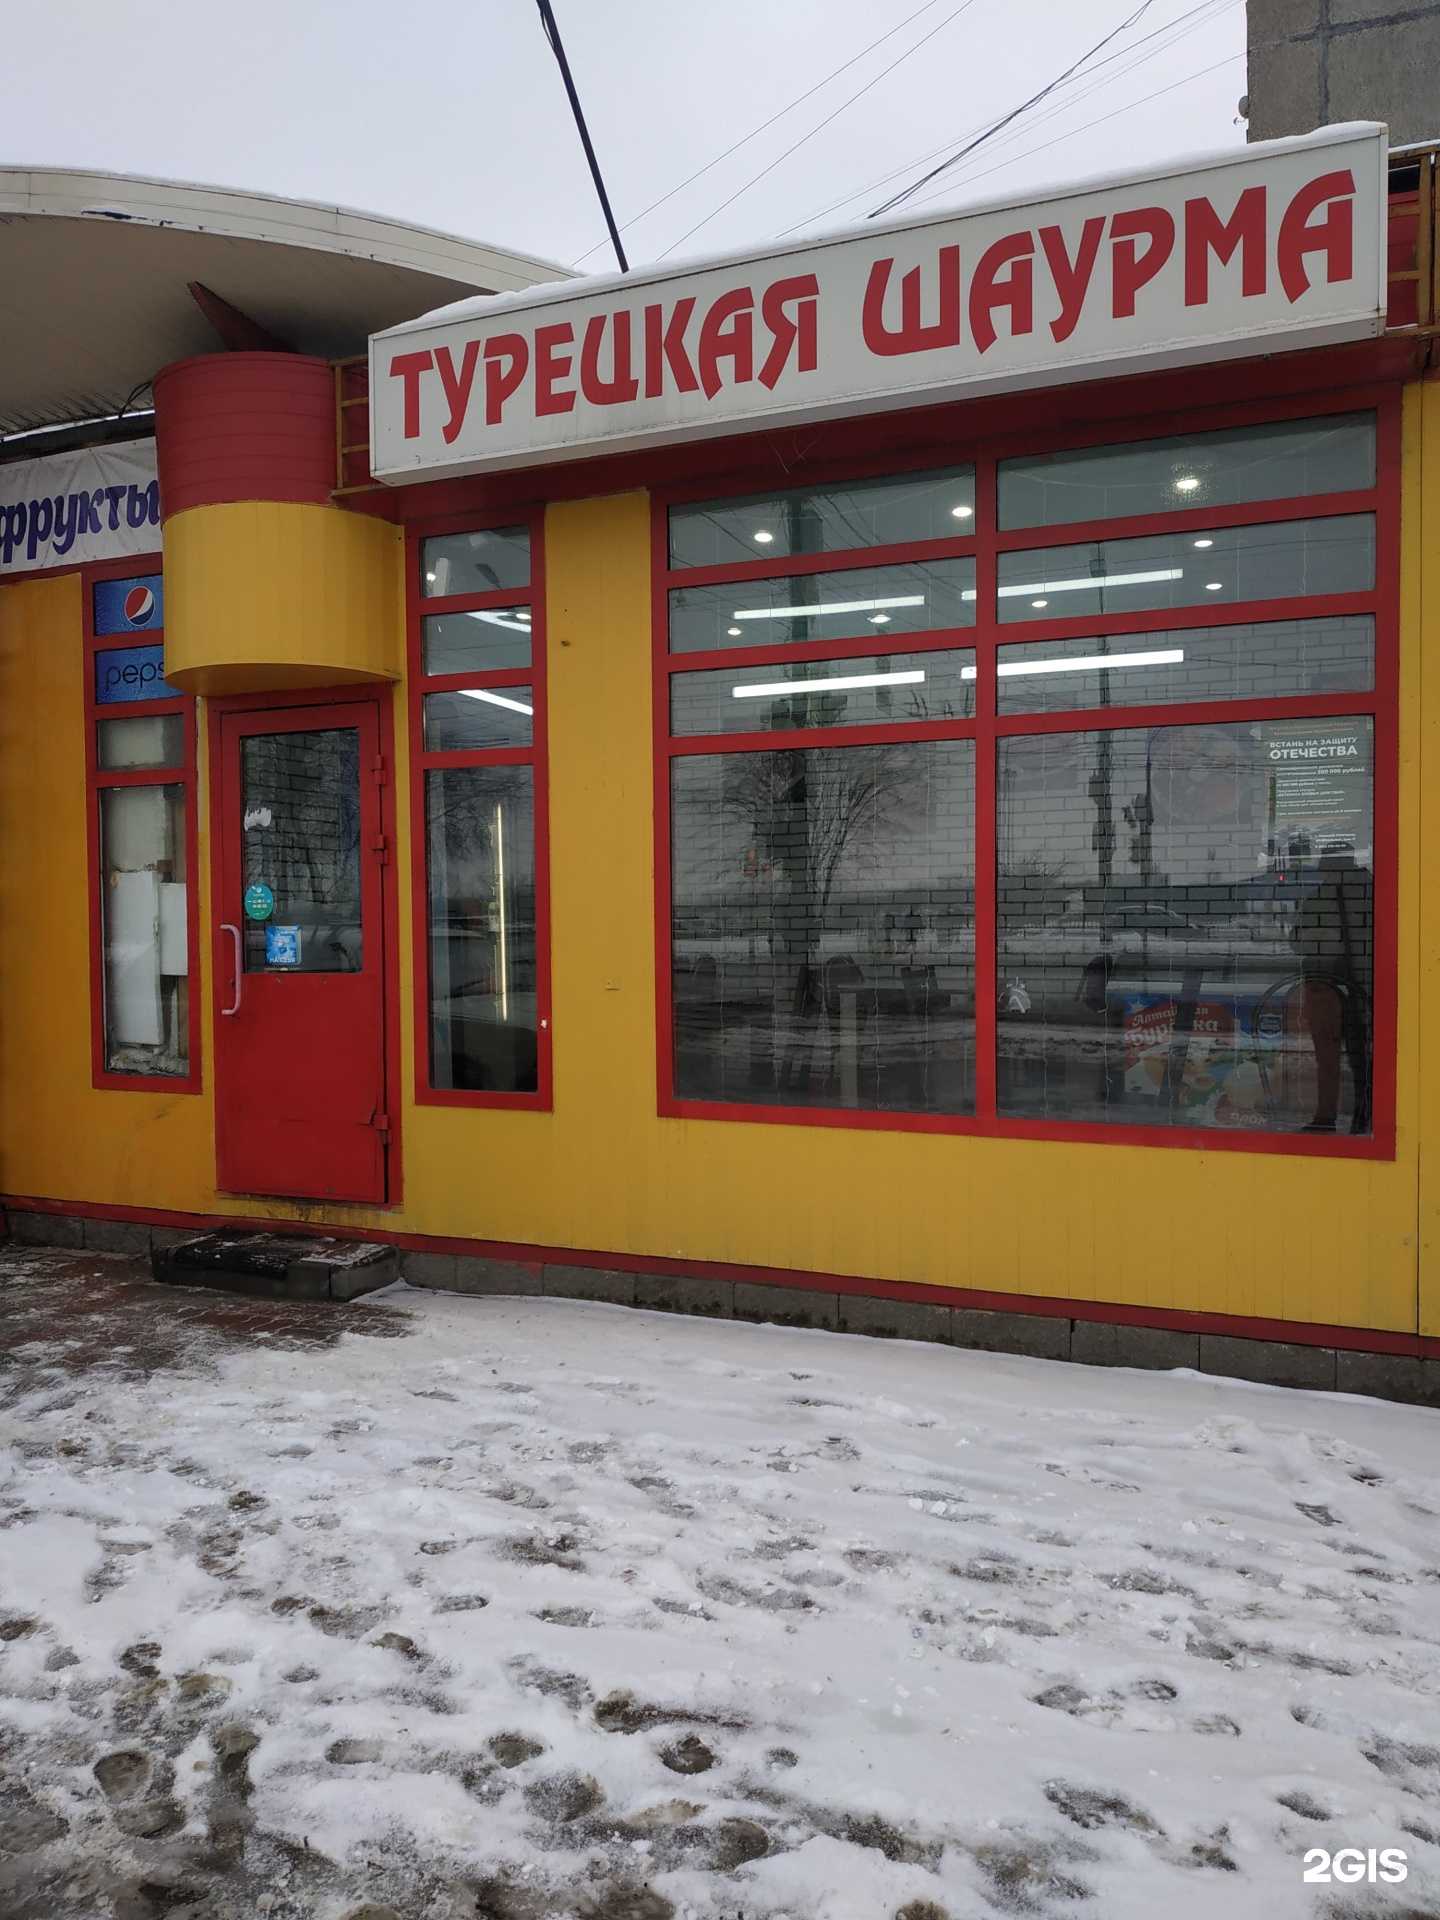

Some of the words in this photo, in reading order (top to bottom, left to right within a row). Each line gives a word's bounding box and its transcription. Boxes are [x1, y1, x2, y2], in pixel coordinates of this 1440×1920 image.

[389, 275, 818, 444] ТУРЕЦКАЯ
[862, 171, 1355, 356] ШАУРМА
[1270, 740, 1304, 748] ВСТАНЬ
[1320, 736, 1358, 745] ЗАЩИТУ
[1269, 745, 1358, 760] ОТЕЧЕСТВА
